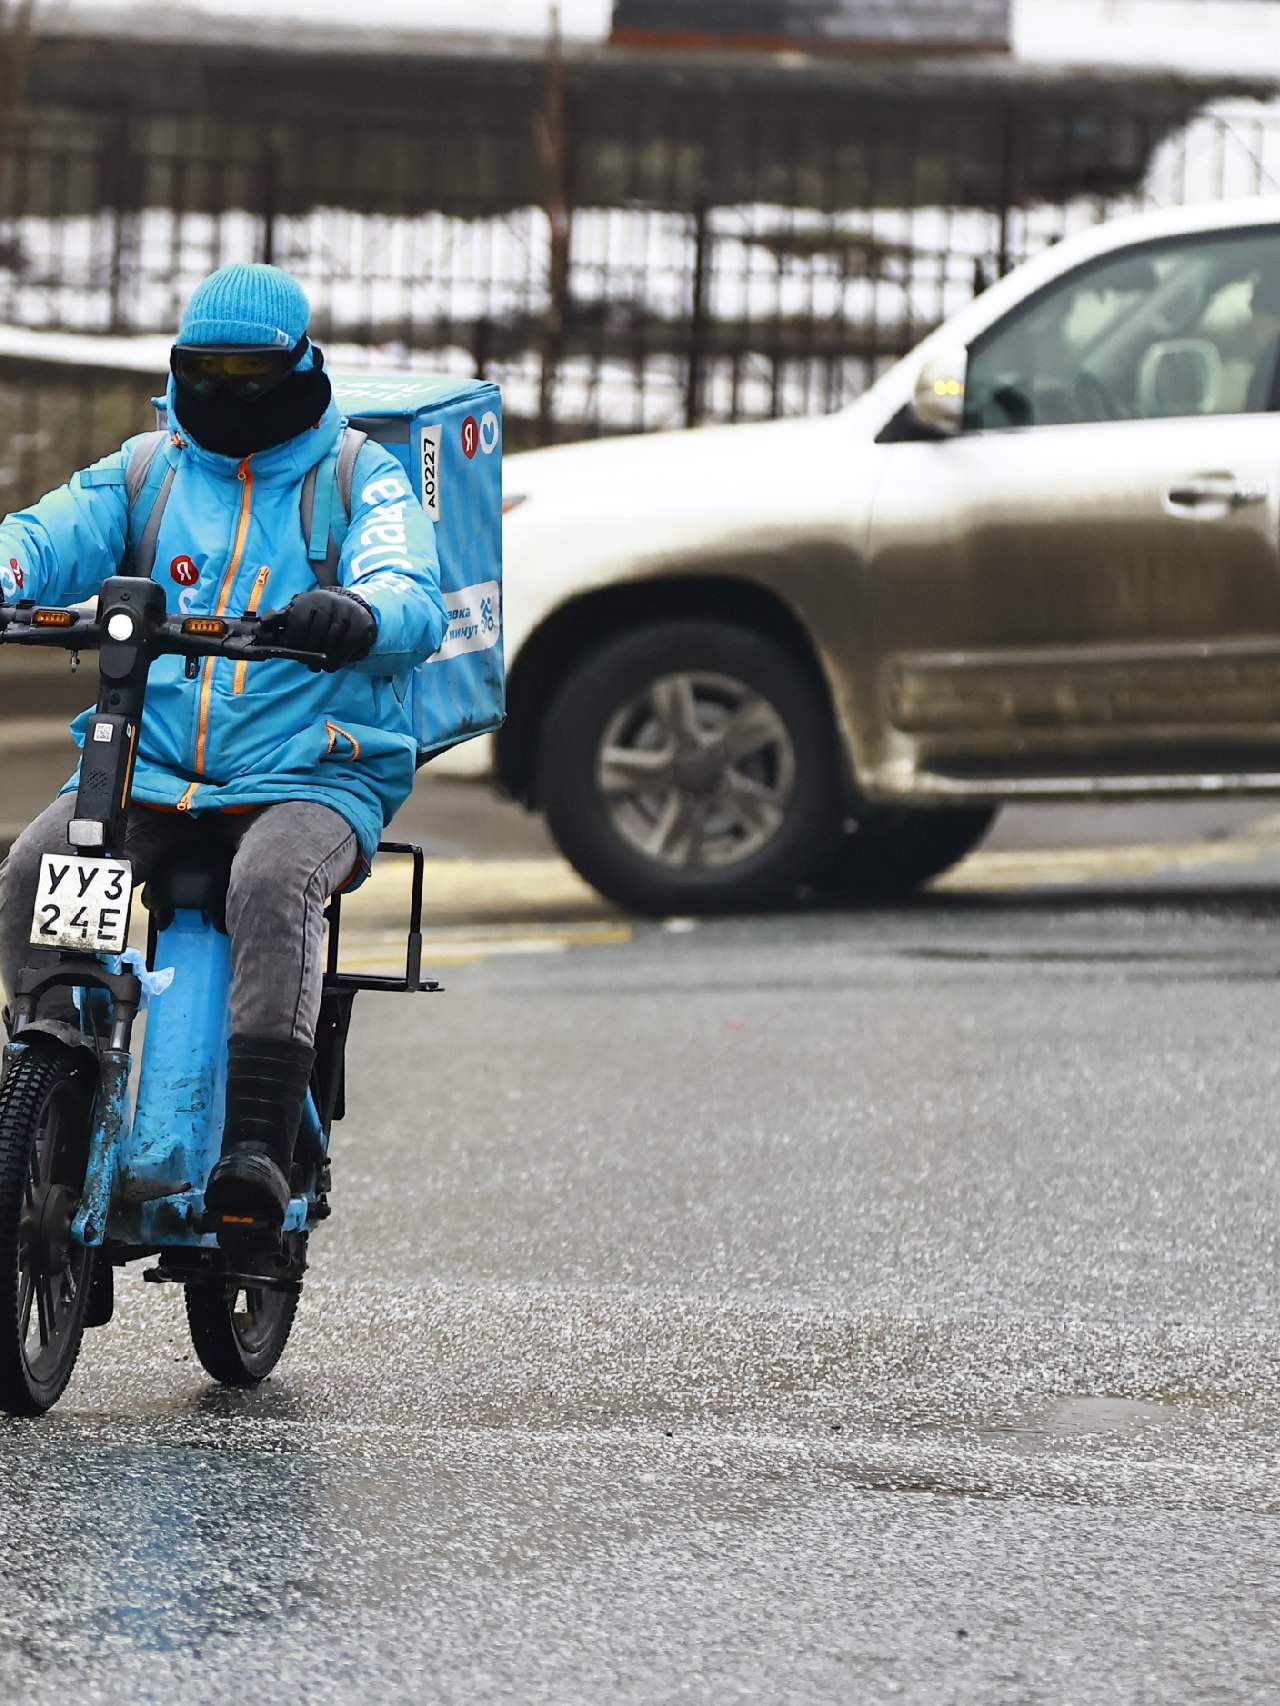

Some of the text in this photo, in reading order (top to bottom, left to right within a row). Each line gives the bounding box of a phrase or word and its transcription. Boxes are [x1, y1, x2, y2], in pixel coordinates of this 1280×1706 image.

[464, 423, 473, 452] Я
[176, 561, 192, 582] Я
[447, 607, 471, 620] авка
[449, 624, 479, 641] минут
